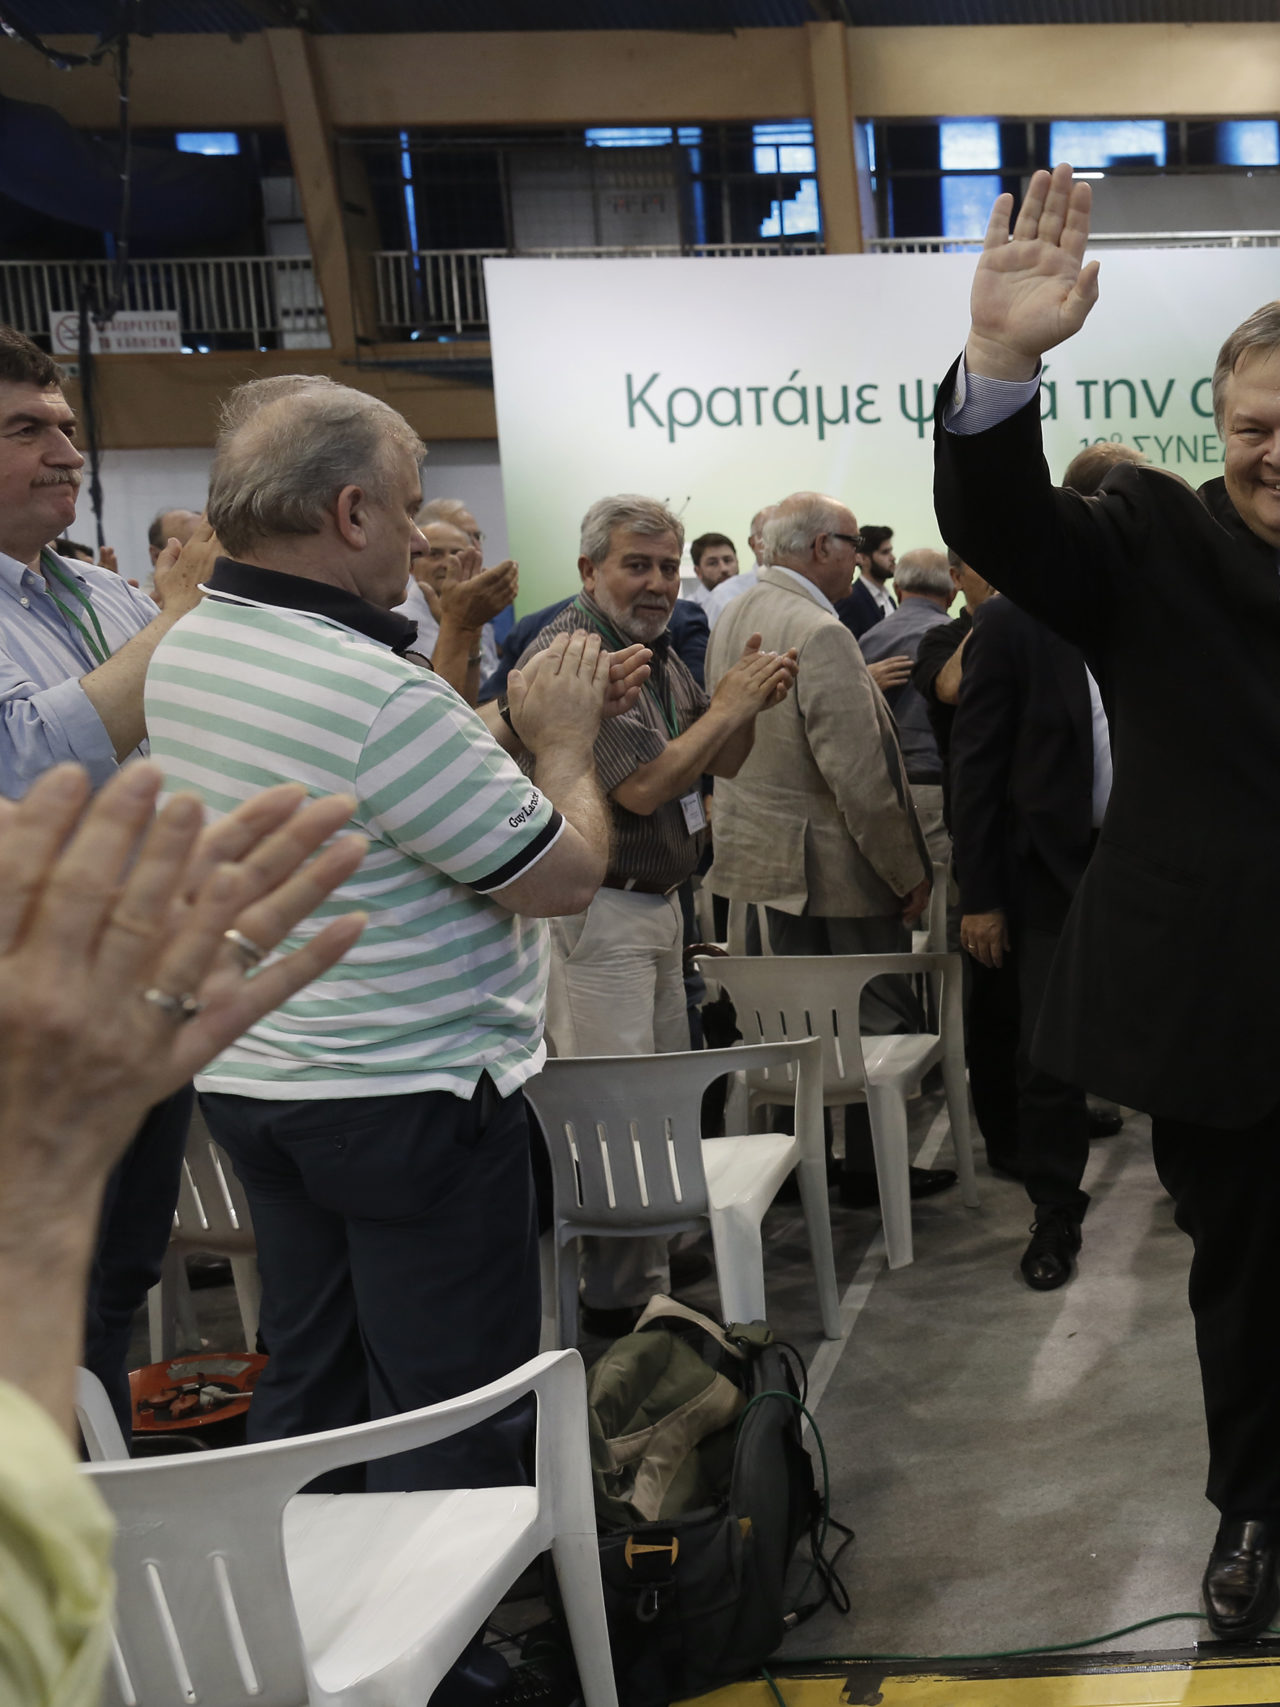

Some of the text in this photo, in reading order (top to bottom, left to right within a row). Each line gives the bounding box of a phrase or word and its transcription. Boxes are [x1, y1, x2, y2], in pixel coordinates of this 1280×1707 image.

[625, 369, 882, 443] Κρατάμε
[899, 364, 1057, 439] ψά
[1076, 378, 1176, 420] την
[1132, 434, 1226, 464] ΣΥΝΕ
[508, 812, 526, 828] Guy
